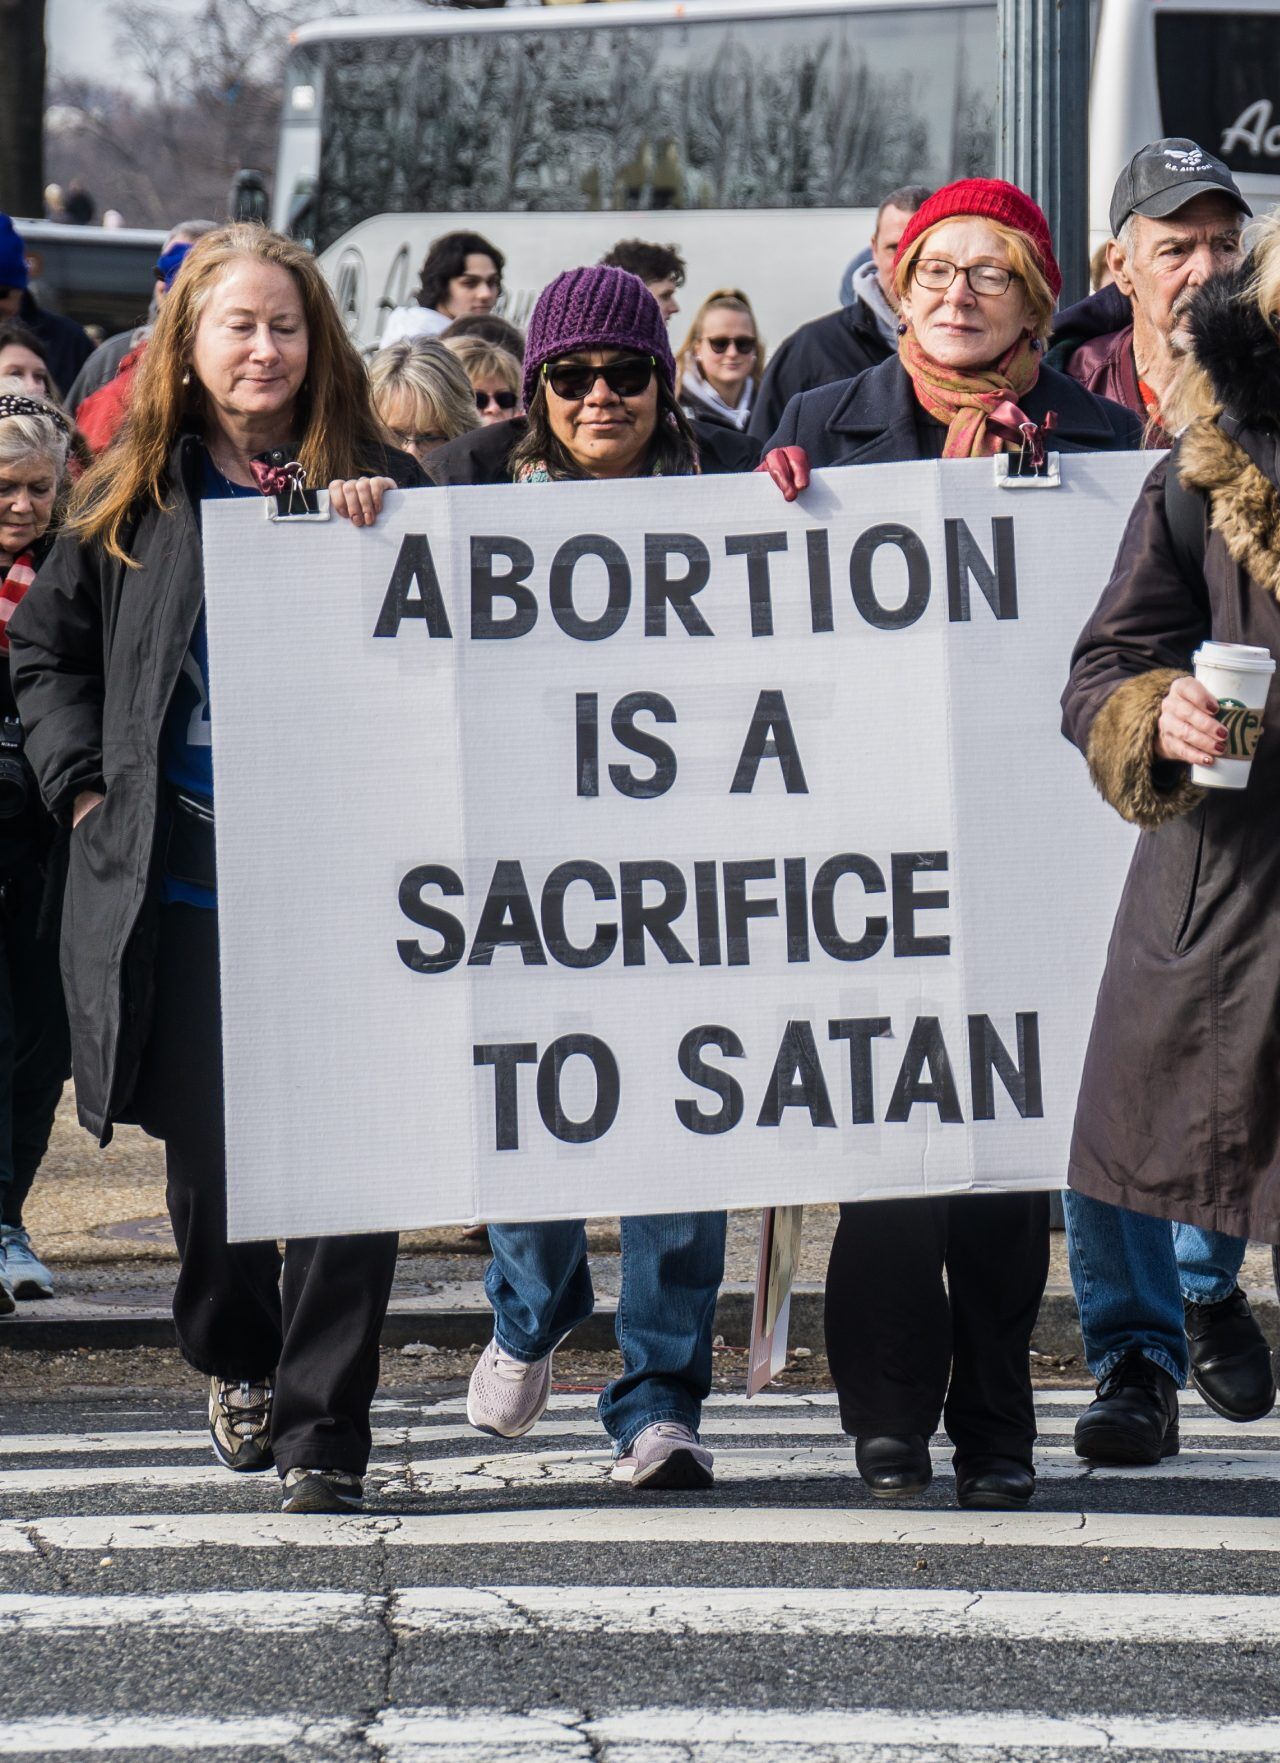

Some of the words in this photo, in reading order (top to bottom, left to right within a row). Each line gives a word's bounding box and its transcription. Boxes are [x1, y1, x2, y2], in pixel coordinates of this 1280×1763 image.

[372, 516, 1019, 642] ABORTION
[575, 691, 677, 800] IS
[729, 690, 809, 794] A
[396, 850, 951, 975] SACRIFICE
[472, 1033, 620, 1151] TO
[674, 1011, 1044, 1135] SATAN
